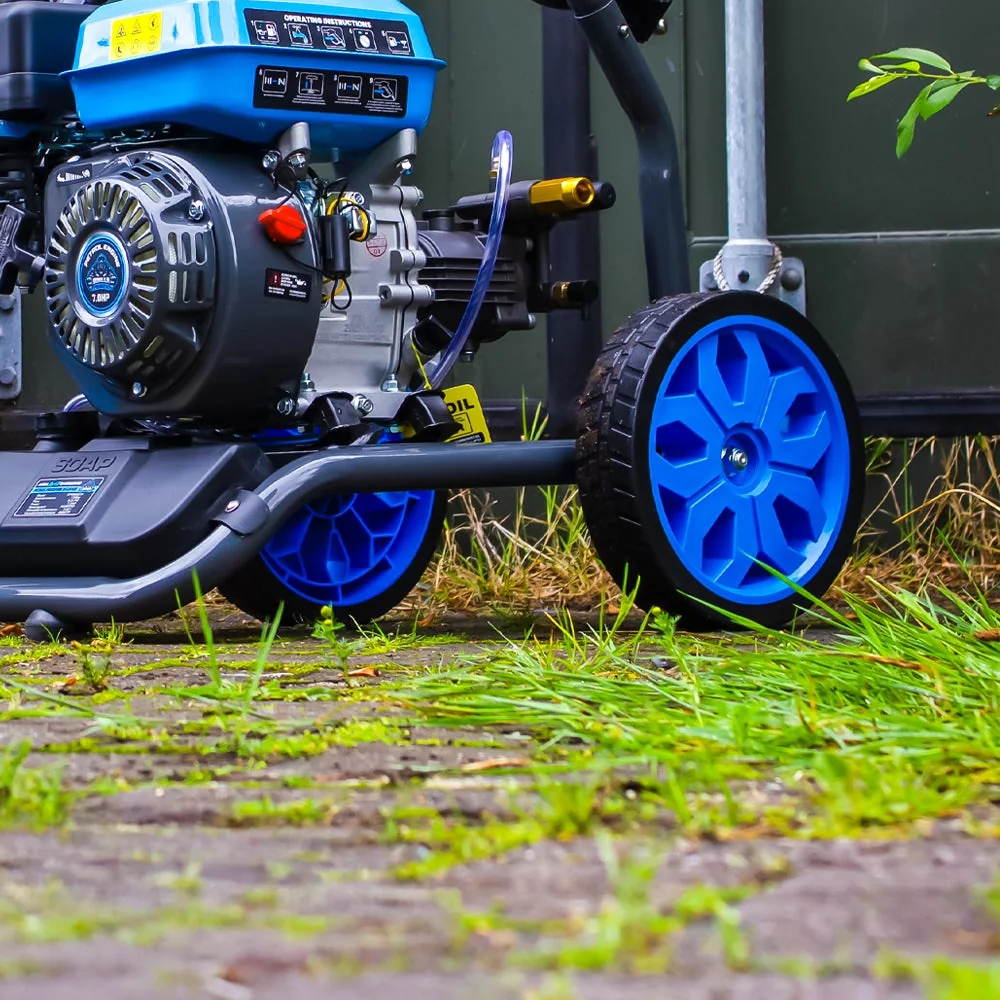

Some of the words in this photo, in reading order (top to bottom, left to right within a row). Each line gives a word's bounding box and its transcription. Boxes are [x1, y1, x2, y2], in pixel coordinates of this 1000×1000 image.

[284, 15, 323, 24] OPERATING
[323, 18, 372, 29] INSTRUCTIONS
[446, 398, 475, 414] OIL
[51, 456, 118, 474] SOAP
